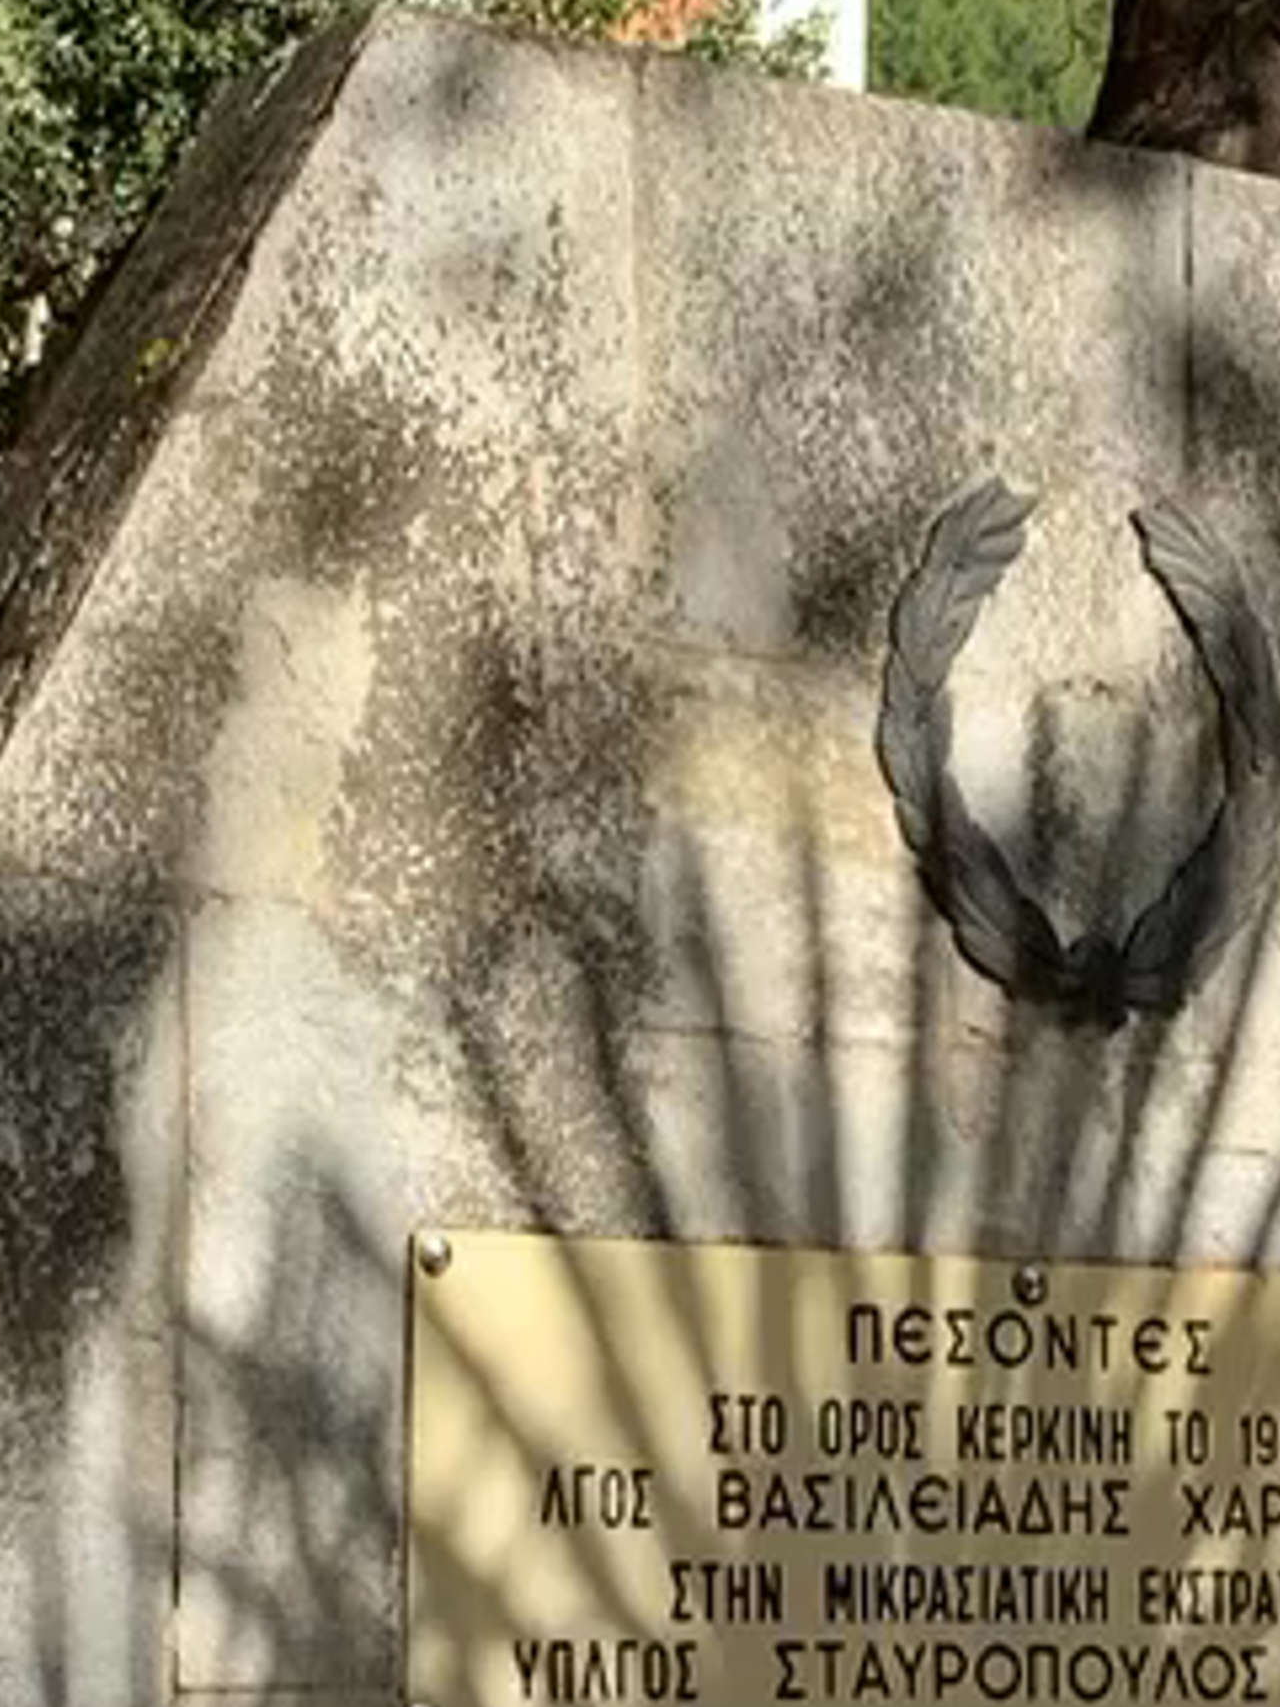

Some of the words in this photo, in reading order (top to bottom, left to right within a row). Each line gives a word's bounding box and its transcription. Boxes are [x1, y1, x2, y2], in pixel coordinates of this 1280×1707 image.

[846, 1301, 1214, 1377] ΠΕΣΟΝΤΕΣ
[709, 1393, 786, 1457] ΣΤΟ
[817, 1397, 923, 1461] ΟΡΟΣ
[955, 1401, 1134, 1465] ΚΕΡΚΙΝΗ
[1165, 1409, 1212, 1469] ΤΟ
[716, 1467, 1131, 1537] ΒΑΣΙΛΕΙΑΔΗΣ
[668, 1559, 784, 1625] ΣΤΗΝ
[823, 1563, 1111, 1626] ΜΙΚΡΑΣΙΑΤΙΚΗ
[772, 1639, 1269, 1703] ΣΤΑΥΡΟΠΟΥΛΟΣ
